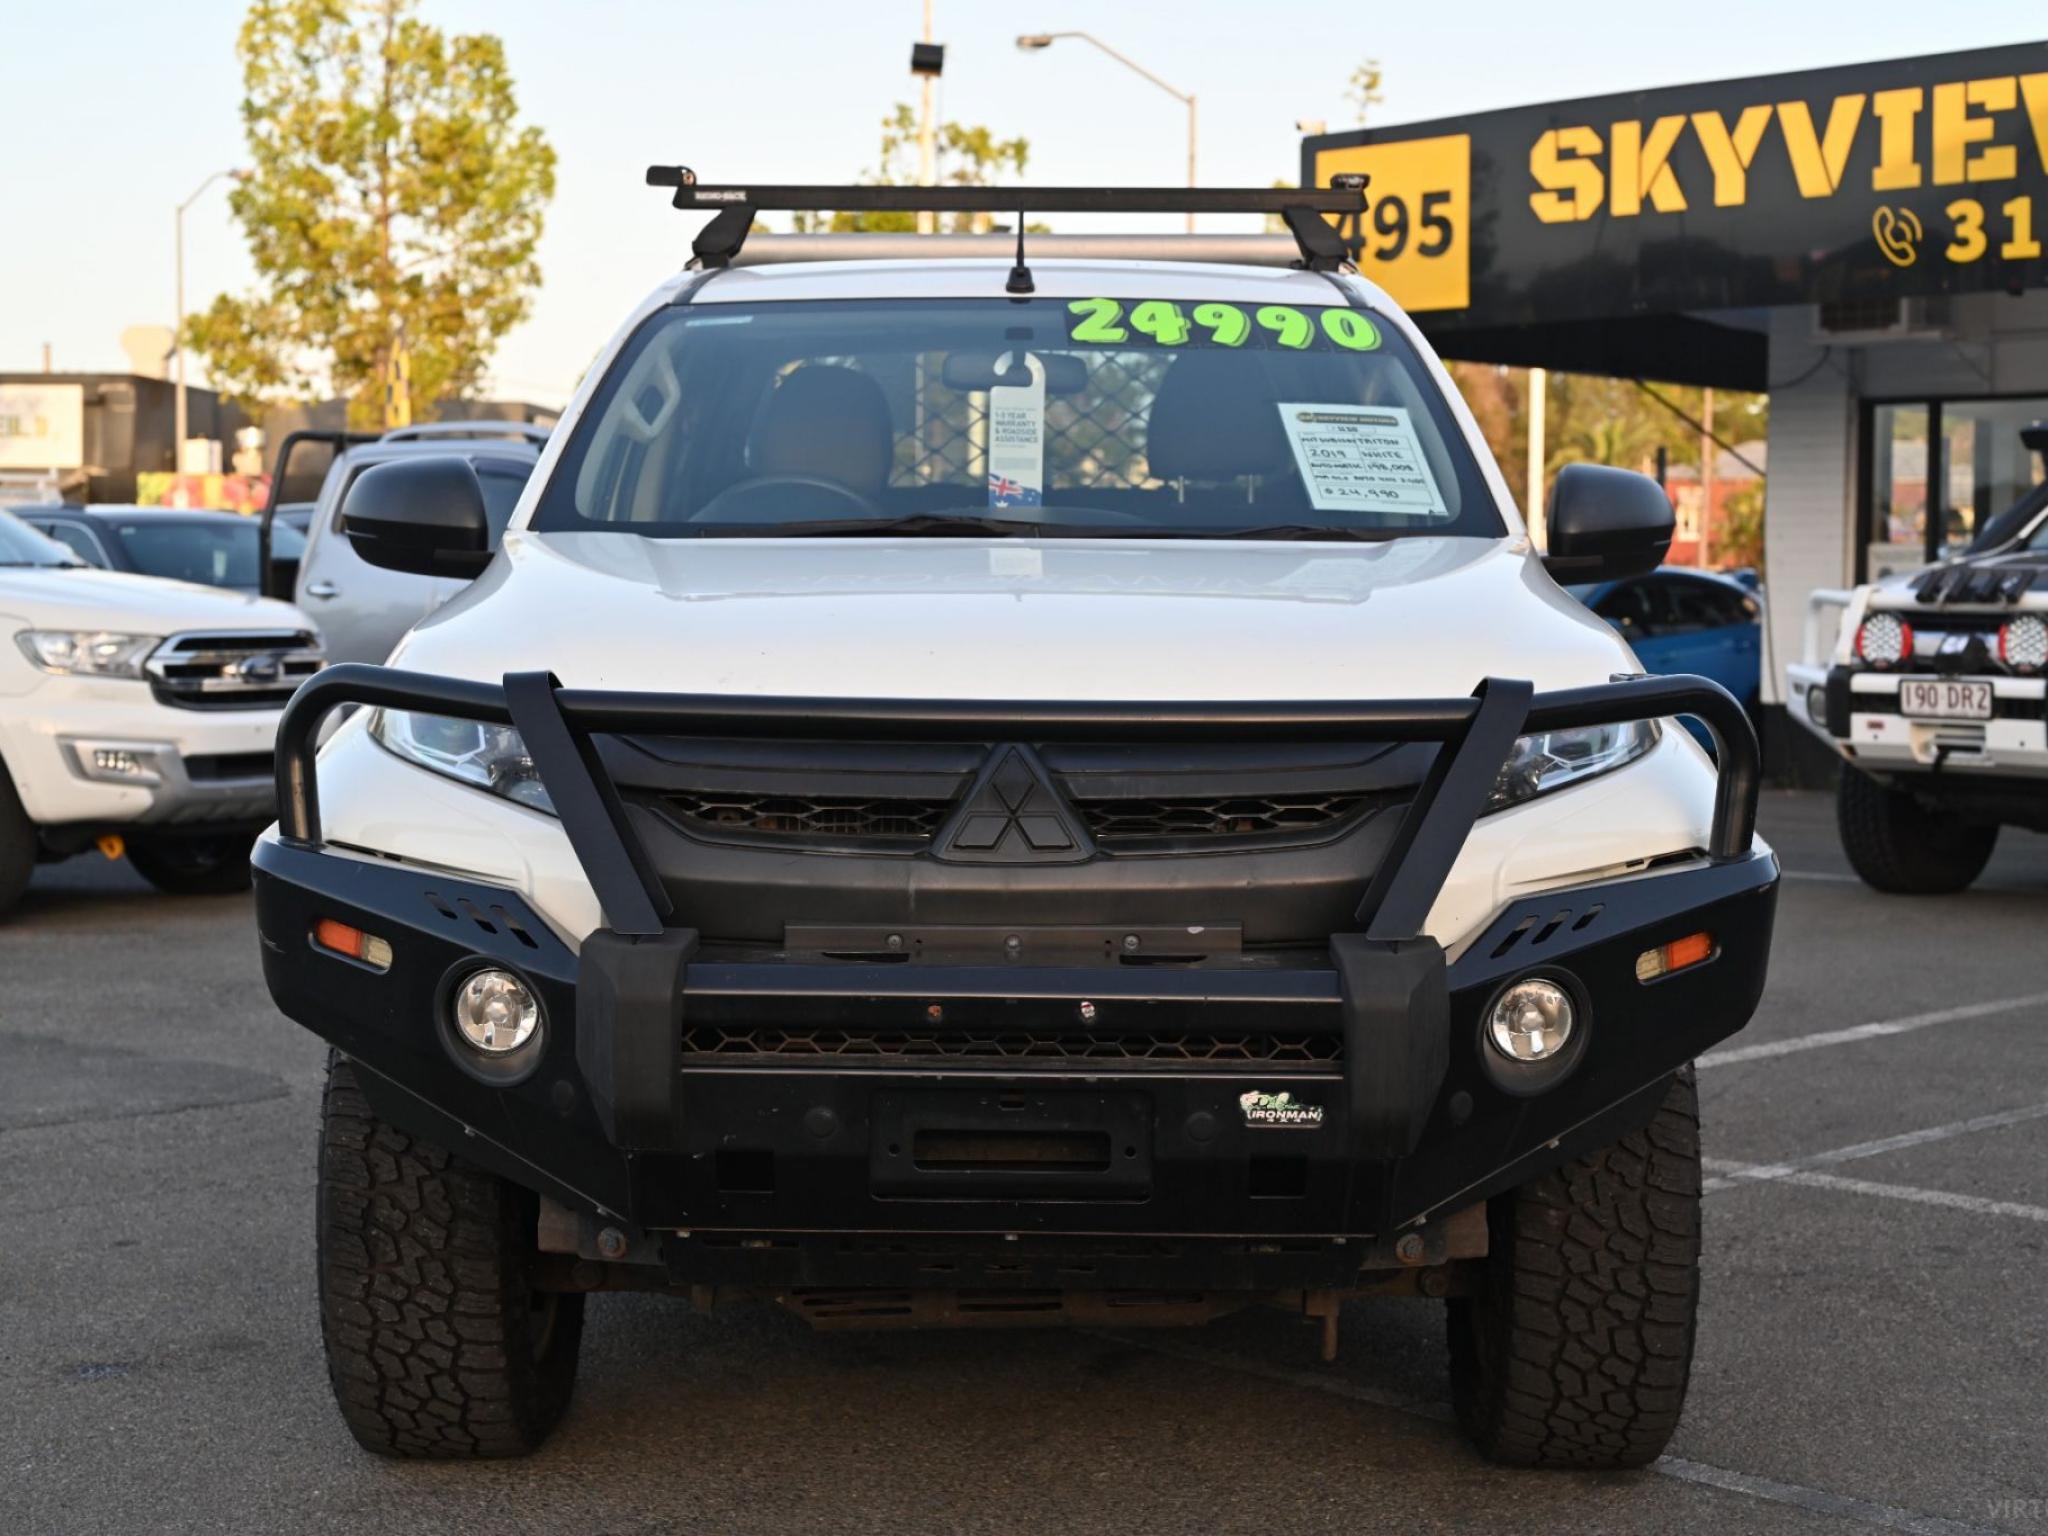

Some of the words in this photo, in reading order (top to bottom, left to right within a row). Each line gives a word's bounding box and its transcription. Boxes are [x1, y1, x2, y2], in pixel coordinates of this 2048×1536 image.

[1530, 72, 2048, 223] SKYVIE
[1067, 297, 1382, 350] 24990
[1358, 437, 1400, 446] TRITON
[1310, 449, 1347, 459] 2019
[1361, 451, 1403, 460] WHITE
[1905, 684, 1939, 709] 190
[1947, 685, 1988, 710] DR2
[1251, 1110, 1318, 1119] IRONMAN
